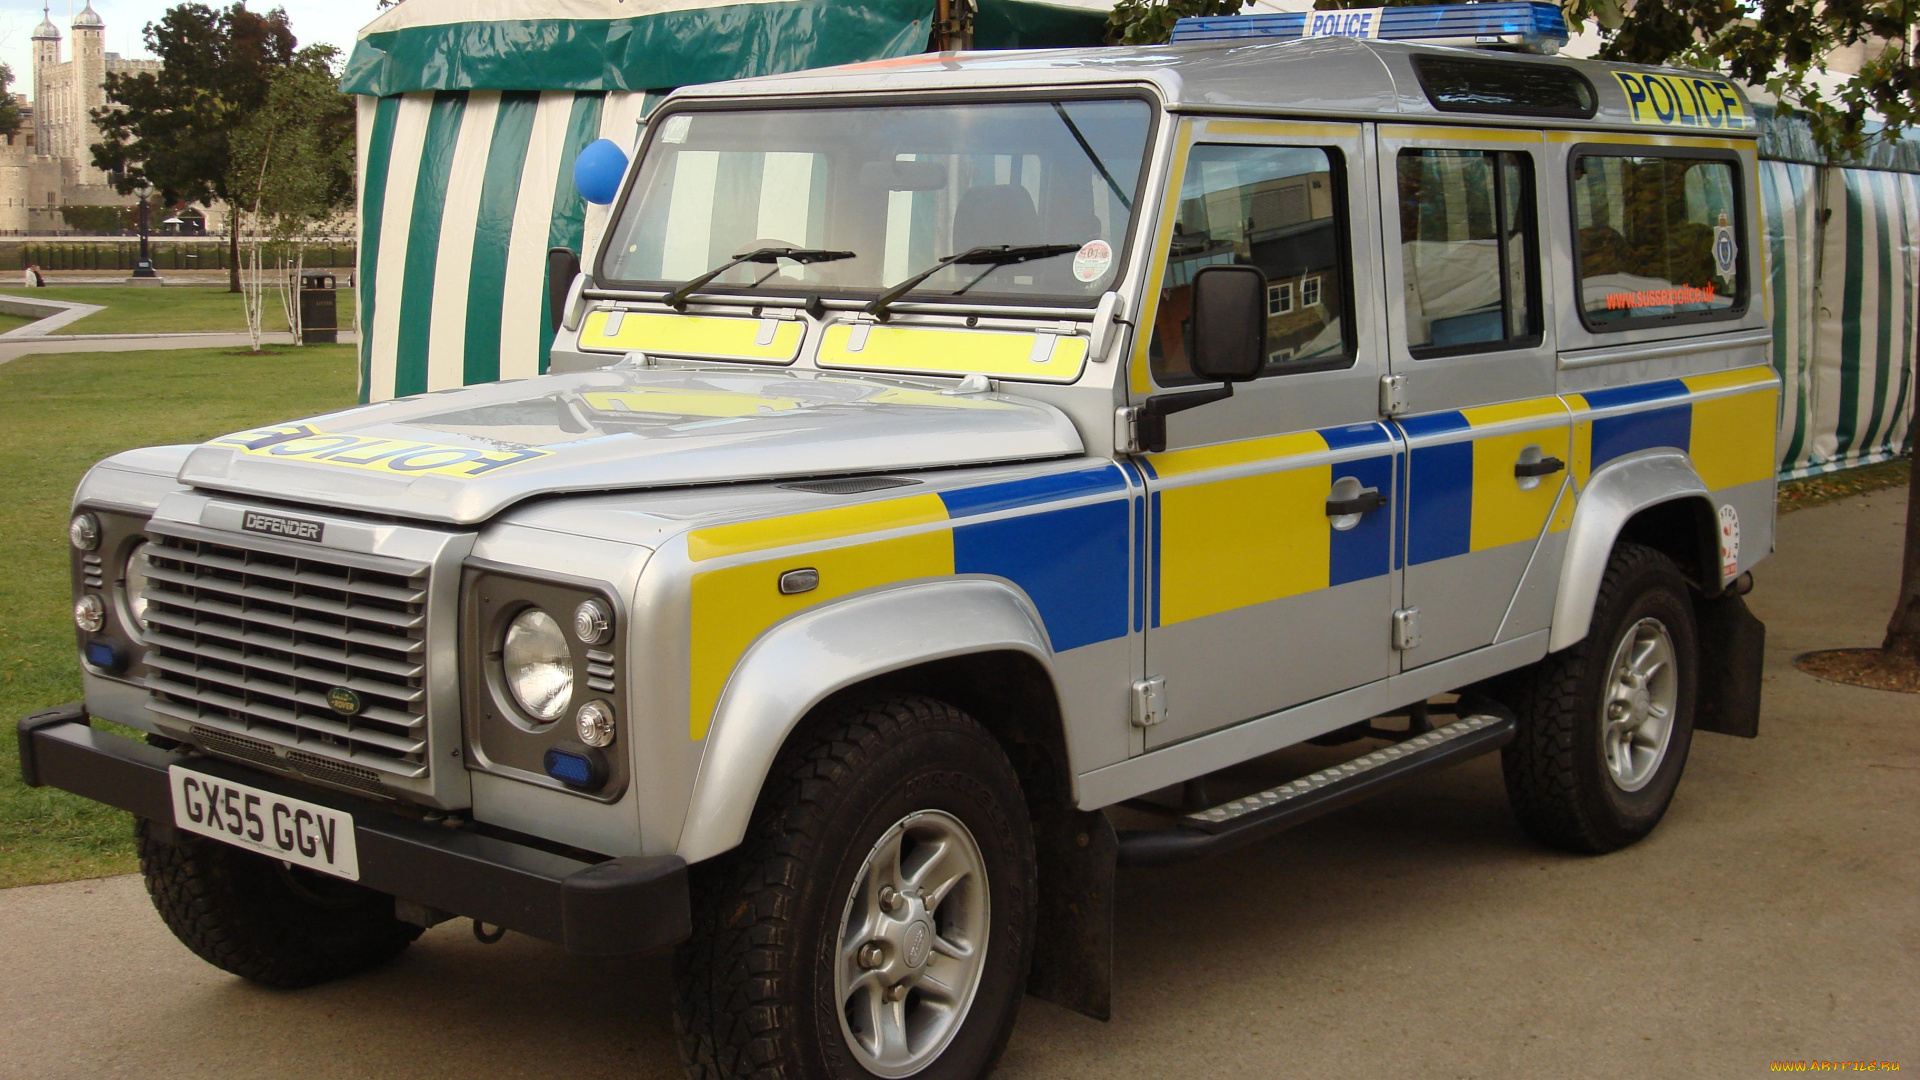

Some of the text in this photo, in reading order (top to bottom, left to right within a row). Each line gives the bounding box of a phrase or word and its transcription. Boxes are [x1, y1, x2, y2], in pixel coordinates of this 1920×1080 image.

[1312, 13, 1373, 38] POLICE
[1616, 72, 1743, 128] POLICE
[246, 512, 321, 540] DEFENDER
[183, 777, 336, 864] GX55 GGV
